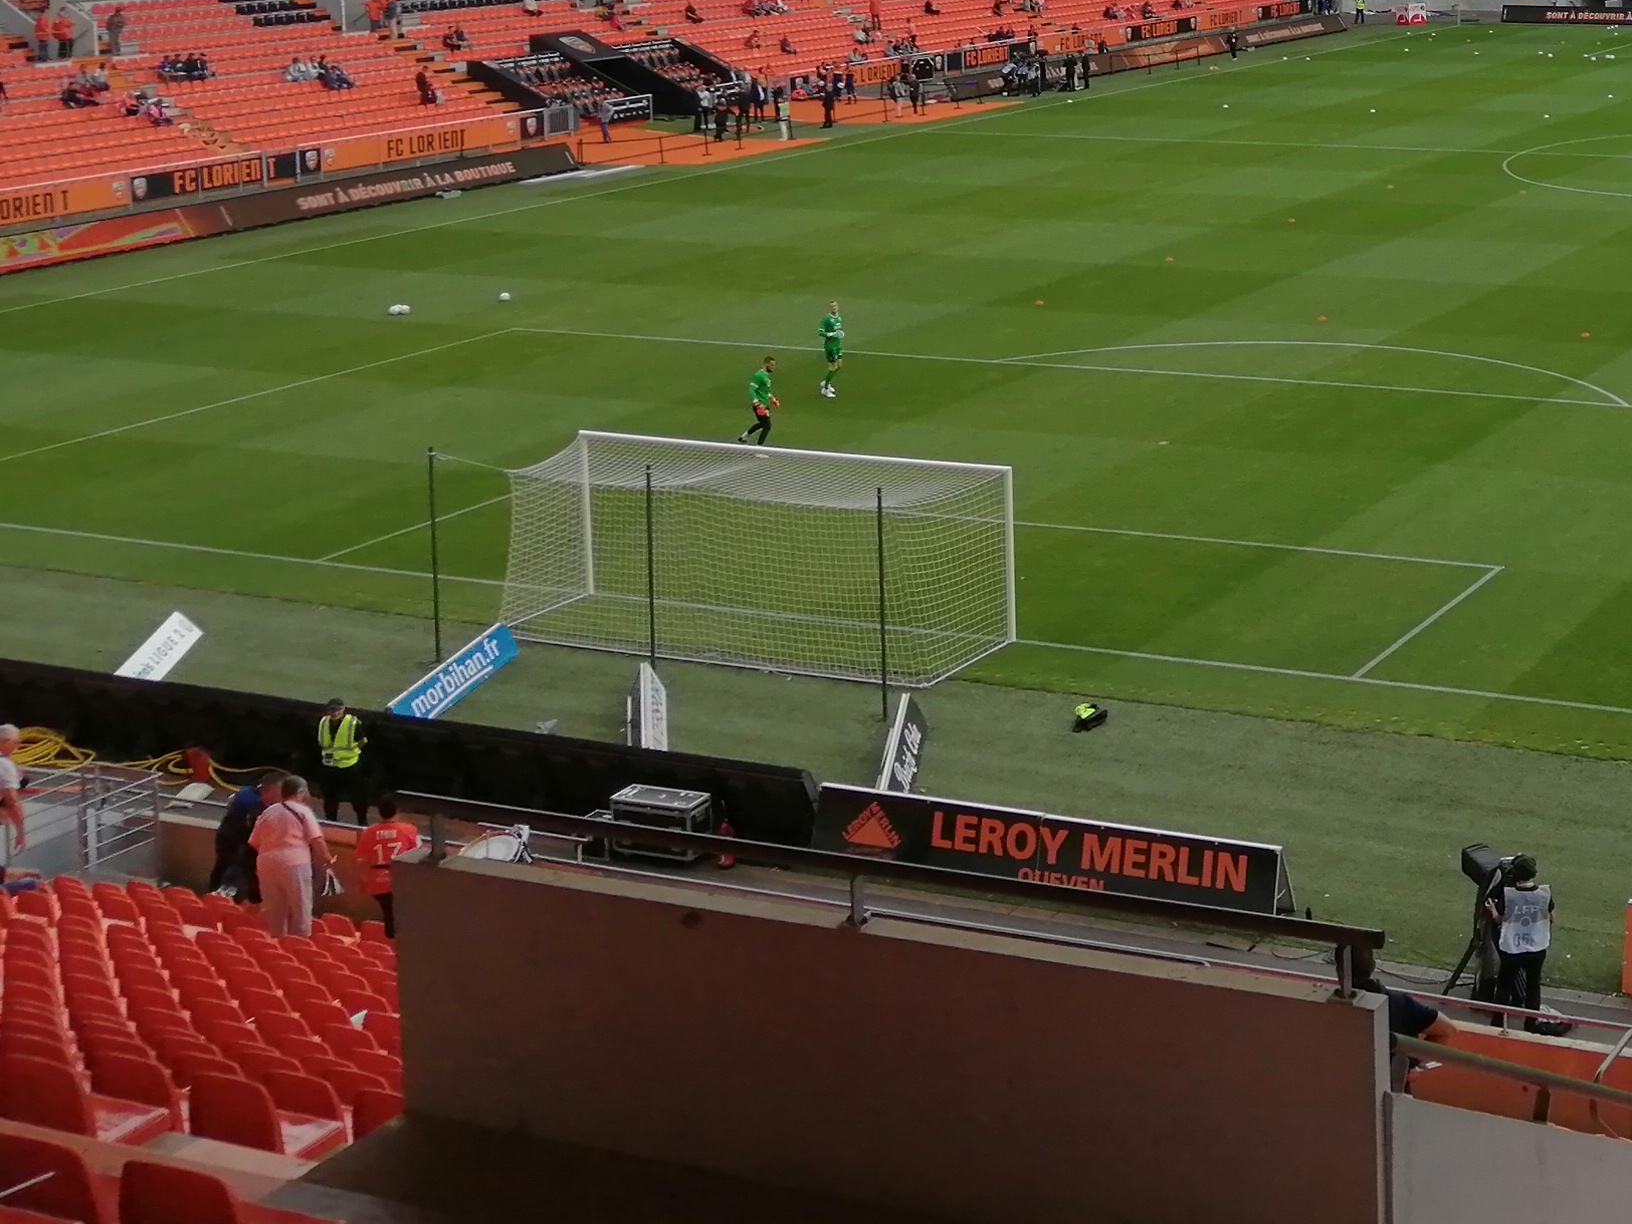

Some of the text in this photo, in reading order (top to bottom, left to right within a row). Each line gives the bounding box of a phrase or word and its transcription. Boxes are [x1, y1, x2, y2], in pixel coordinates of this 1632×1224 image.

[1546, 11, 1568, 20] SONT
[1577, 10, 1625, 21] DÉCOUVRIR
[966, 45, 1009, 66] FC LORIENT
[1061, 37, 1070, 51] FC
[387, 139, 404, 158] FC
[173, 170, 197, 194] FC
[298, 192, 336, 210] SONT
[336, 186, 349, 204] À
[350, 174, 424, 202] DÉCOUVRIR
[437, 171, 456, 187] LA
[456, 162, 516, 182] BOUTIQUE
[147, 635, 179, 665] LIGUE
[410, 637, 501, 718] morbihan.fr
[373, 842, 402, 865] 17
[930, 811, 1249, 894] LEROY MERLIN
[1514, 905, 1540, 915] LFP
